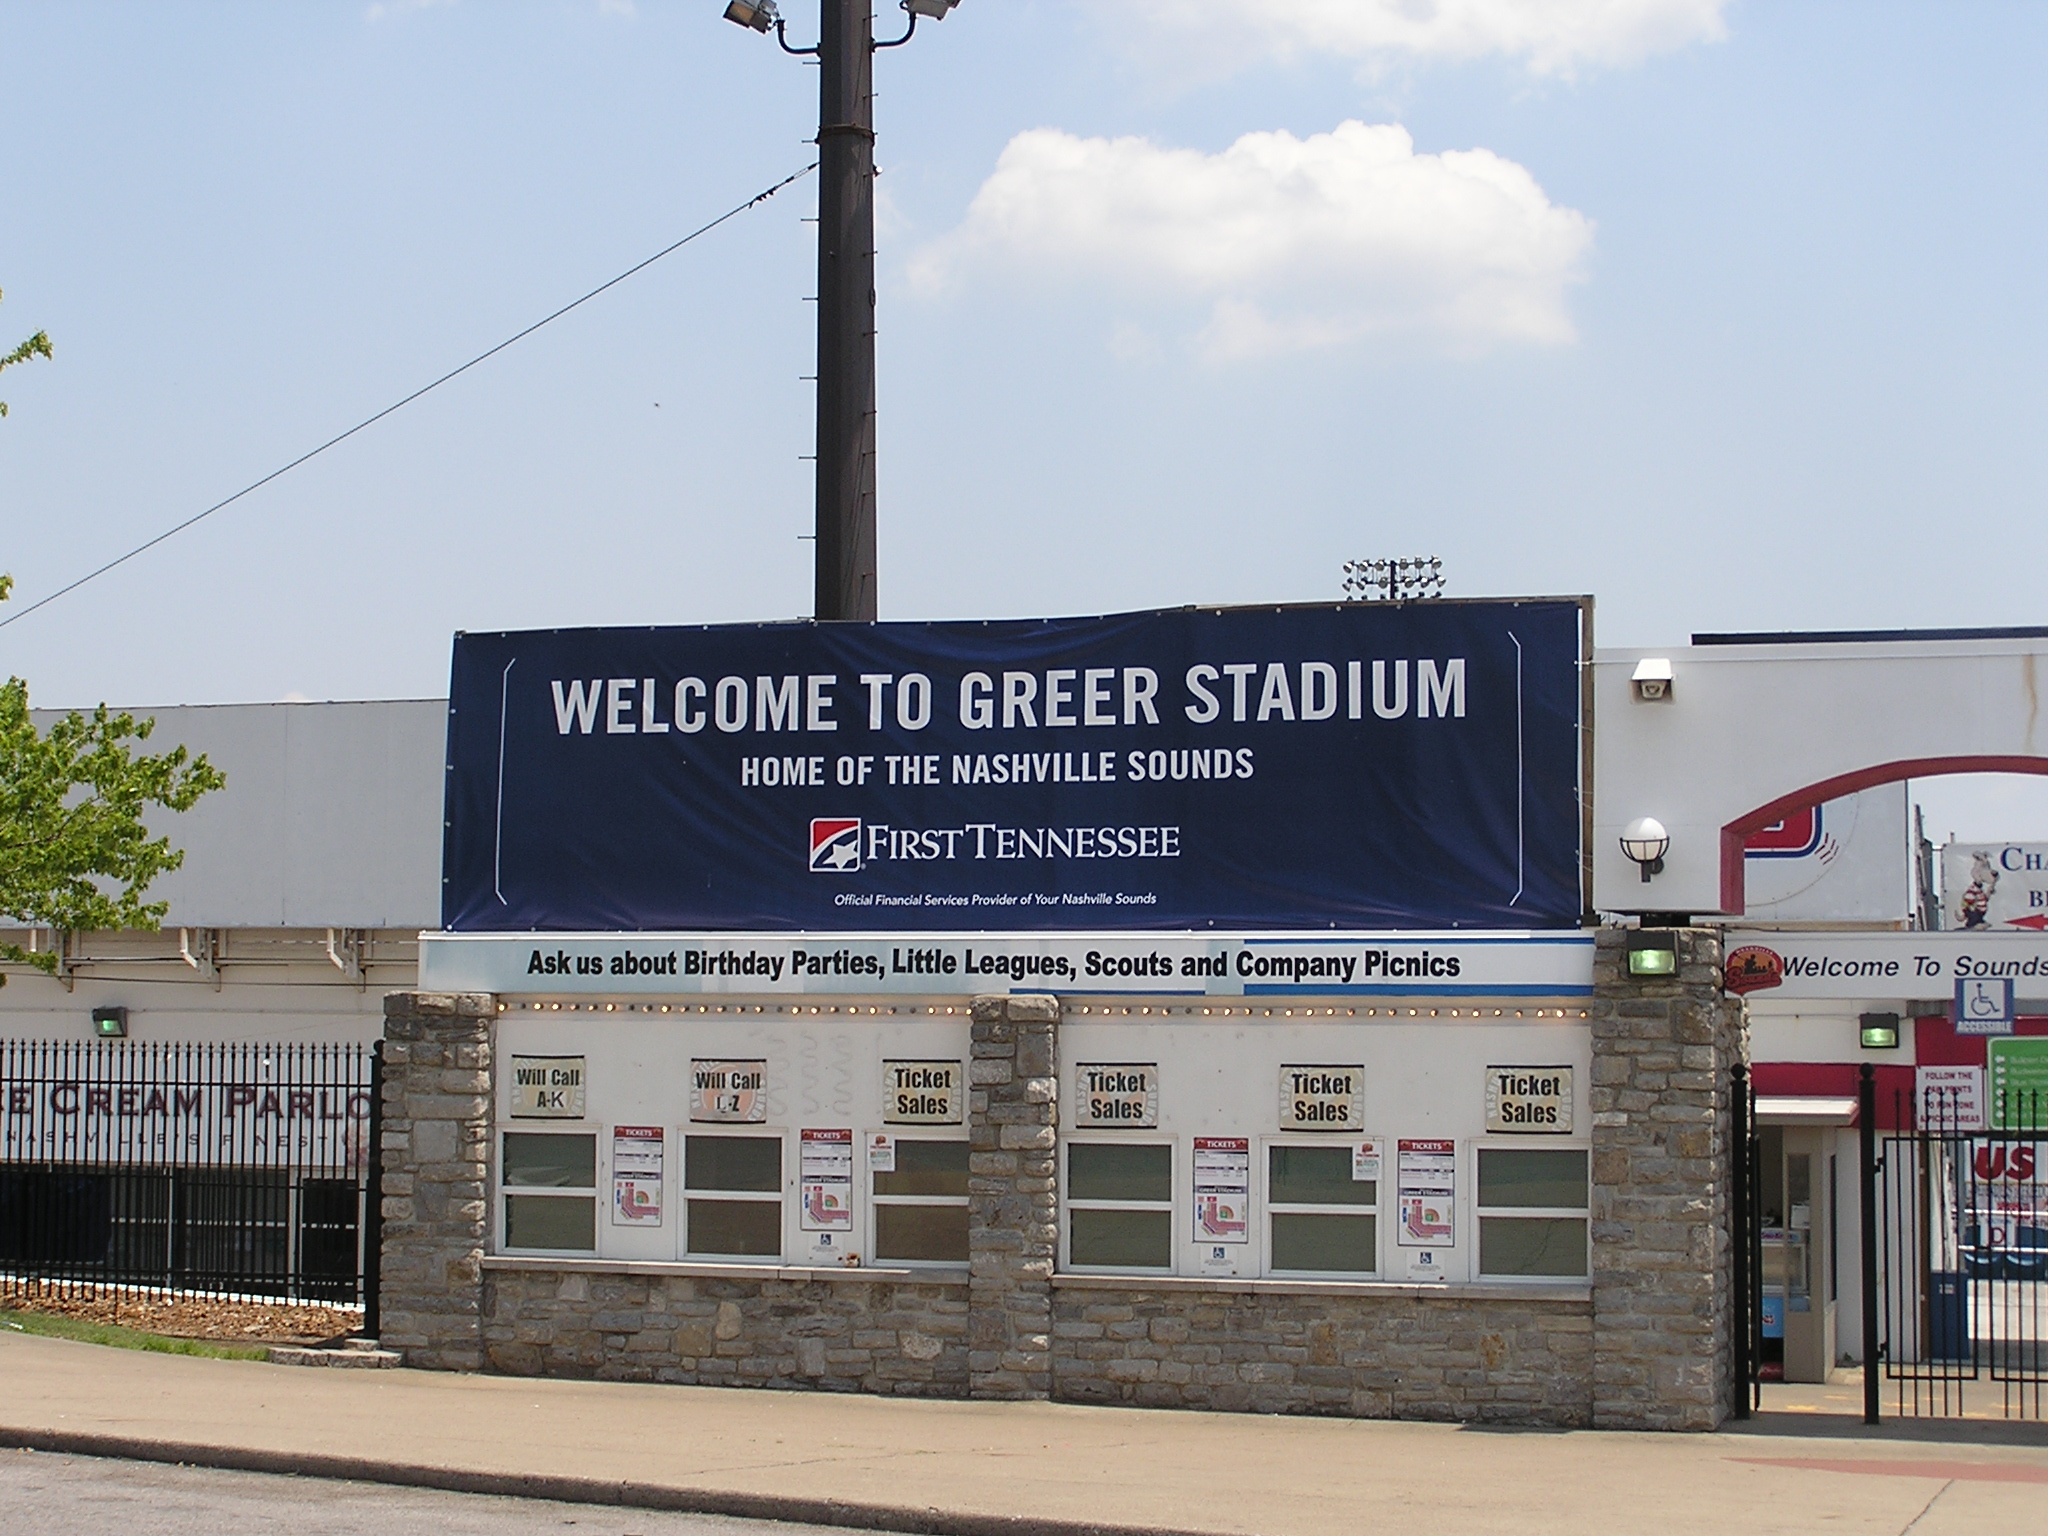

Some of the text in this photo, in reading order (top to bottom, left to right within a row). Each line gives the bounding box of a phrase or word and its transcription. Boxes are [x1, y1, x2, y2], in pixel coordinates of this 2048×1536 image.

[551, 657, 1467, 736] WELCOME TO GREER STADIUM
[741, 747, 1254, 787] HOME OF THE NASHVILLE SOUNDS
[866, 823, 1181, 861] FIRST TENNESSEE
[2000, 842, 2048, 872] CH
[834, 891, 1157, 906] Official Financial Services Provider of Your Nashville Sounds
[2029, 890, 2048, 908] B
[527, 948, 1461, 983] Ask us about Birthday Parties, Little Leagues, Scouts and Company Picnics
[1782, 955, 2048, 977] Welcome To Sounds
[517, 1068, 580, 1086] Will Call
[695, 1072, 761, 1090] Will Call
[894, 1068, 951, 1089] Ticket
[1087, 1071, 1146, 1093] Ticket
[1291, 1073, 1352, 1095] Ticket
[1498, 1074, 1560, 1096] Ticket
[1925, 1071, 1973, 1080] FOLLOW THE
[537, 1090, 564, 1108] A-K
[1944, 1085, 1972, 1093] PRNTS
[0, 1086, 31, 1115] E
[50, 1083, 201, 1118] CREAM
[897, 1094, 948, 1115] Sales
[1090, 1098, 1143, 1119] Sales
[1294, 1100, 1348, 1122] Sales
[1953, 1101, 1975, 1110] ONE
[1501, 1101, 1557, 1124] Sales
[1927, 1115, 1953, 1123] PICIC
[223, 1134, 328, 1148] FNEST
[625, 1128, 653, 1137] TICKETS
[813, 1131, 841, 1140] TICKETS
[1206, 1140, 1237, 1149] TICKETS
[1411, 1142, 1442, 1150] TICKETS
